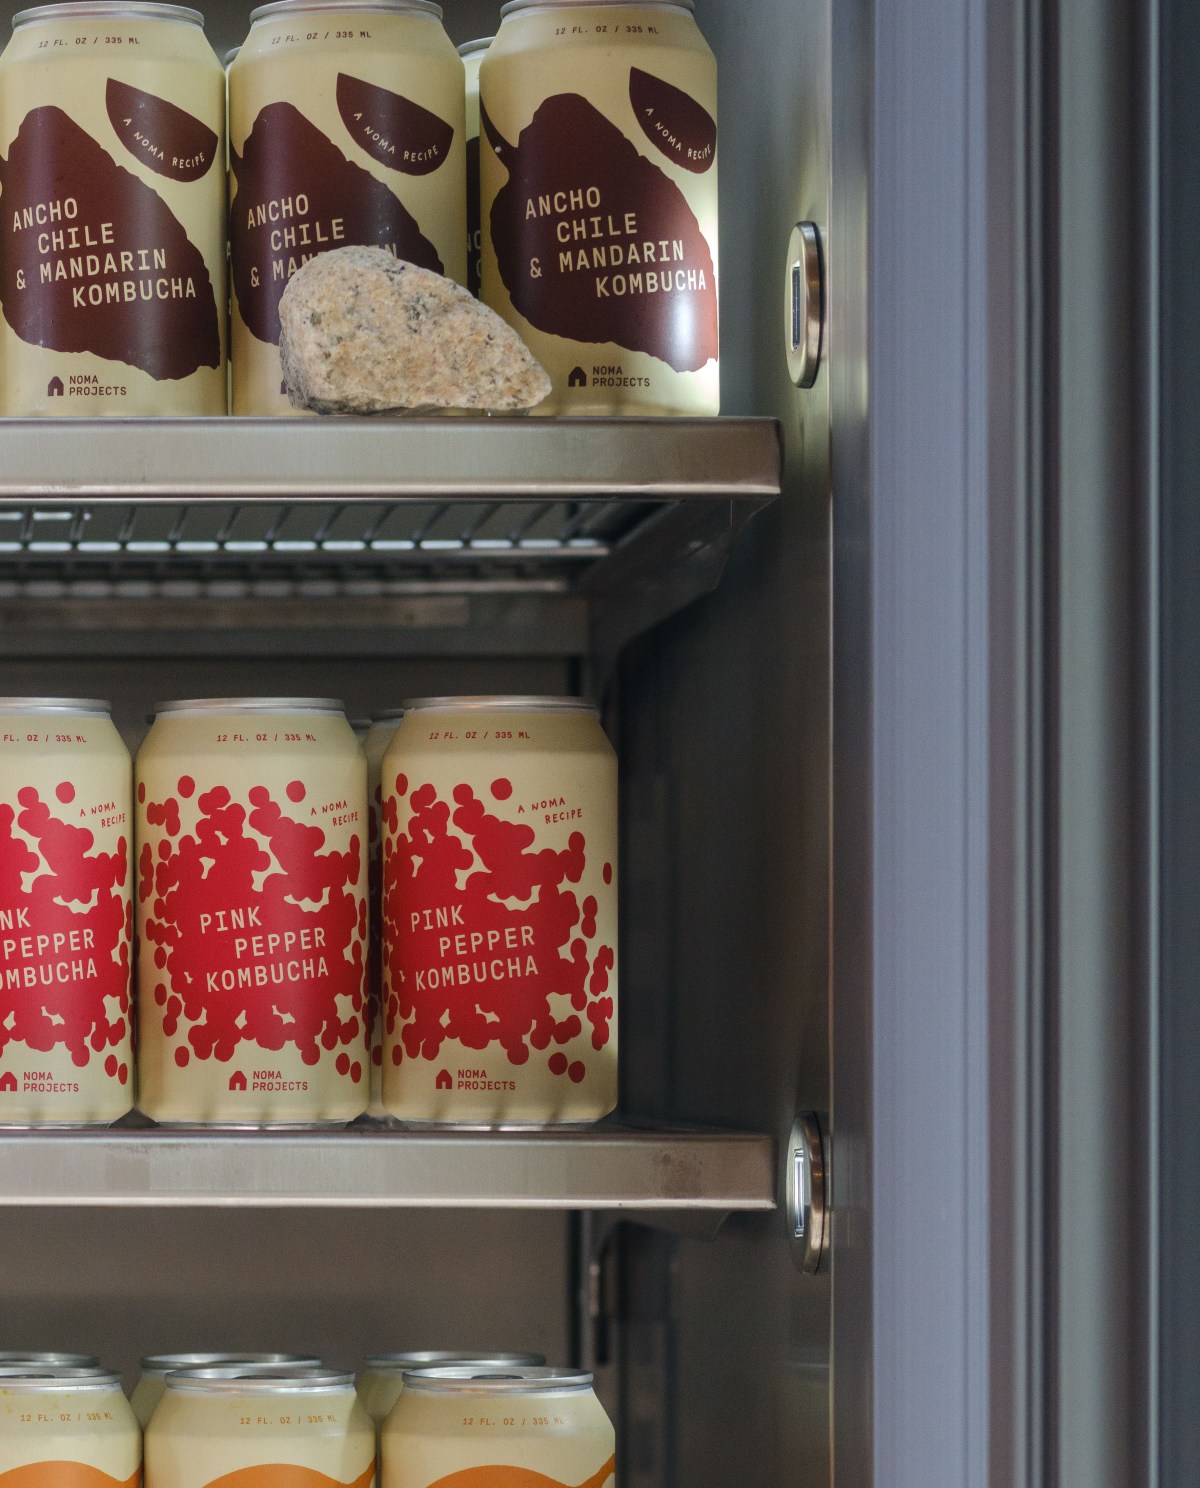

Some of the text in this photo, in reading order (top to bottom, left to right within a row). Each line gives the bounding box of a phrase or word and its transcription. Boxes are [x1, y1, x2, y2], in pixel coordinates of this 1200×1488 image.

[38, 40, 49, 49] 12
[75, 36, 86, 46] OZ
[105, 36, 122, 45] 335
[128, 36, 141, 45] ML
[123, 116, 205, 169] A NOMA RECIPE
[645, 107, 711, 160] A NOMA RECIPE
[13, 197, 78, 233] ANCHO
[247, 193, 309, 230] ANCHO
[525, 186, 601, 221] ANCHO
[37, 222, 115, 254] CHILE
[270, 218, 345, 252] CHILE
[556, 212, 638, 243] CHILE
[16, 248, 167, 290] & MANDARIN
[530, 239, 684, 279] & MANDARIN
[250, 266, 260, 288] &
[595, 269, 707, 299] KOMBUCHA
[72, 277, 197, 308] KOMBUCHA
[69, 375, 99, 385] NOMA
[592, 366, 623, 376] NOMA
[592, 377, 650, 387] PROJECTS
[69, 385, 127, 396] PROJECTS
[429, 731, 439, 741] 12
[465, 731, 477, 741] OZ
[494, 731, 514, 740] 335
[518, 731, 531, 740] ML
[517, 797, 566, 813] A NOMA
[544, 808, 583, 824] RECIPE
[410, 905, 464, 933] PINK
[438, 926, 536, 958] PEPPER
[415, 956, 539, 992] KOMBUCHA
[457, 1069, 488, 1079] NOMA
[457, 1081, 516, 1091] PROJECTS
